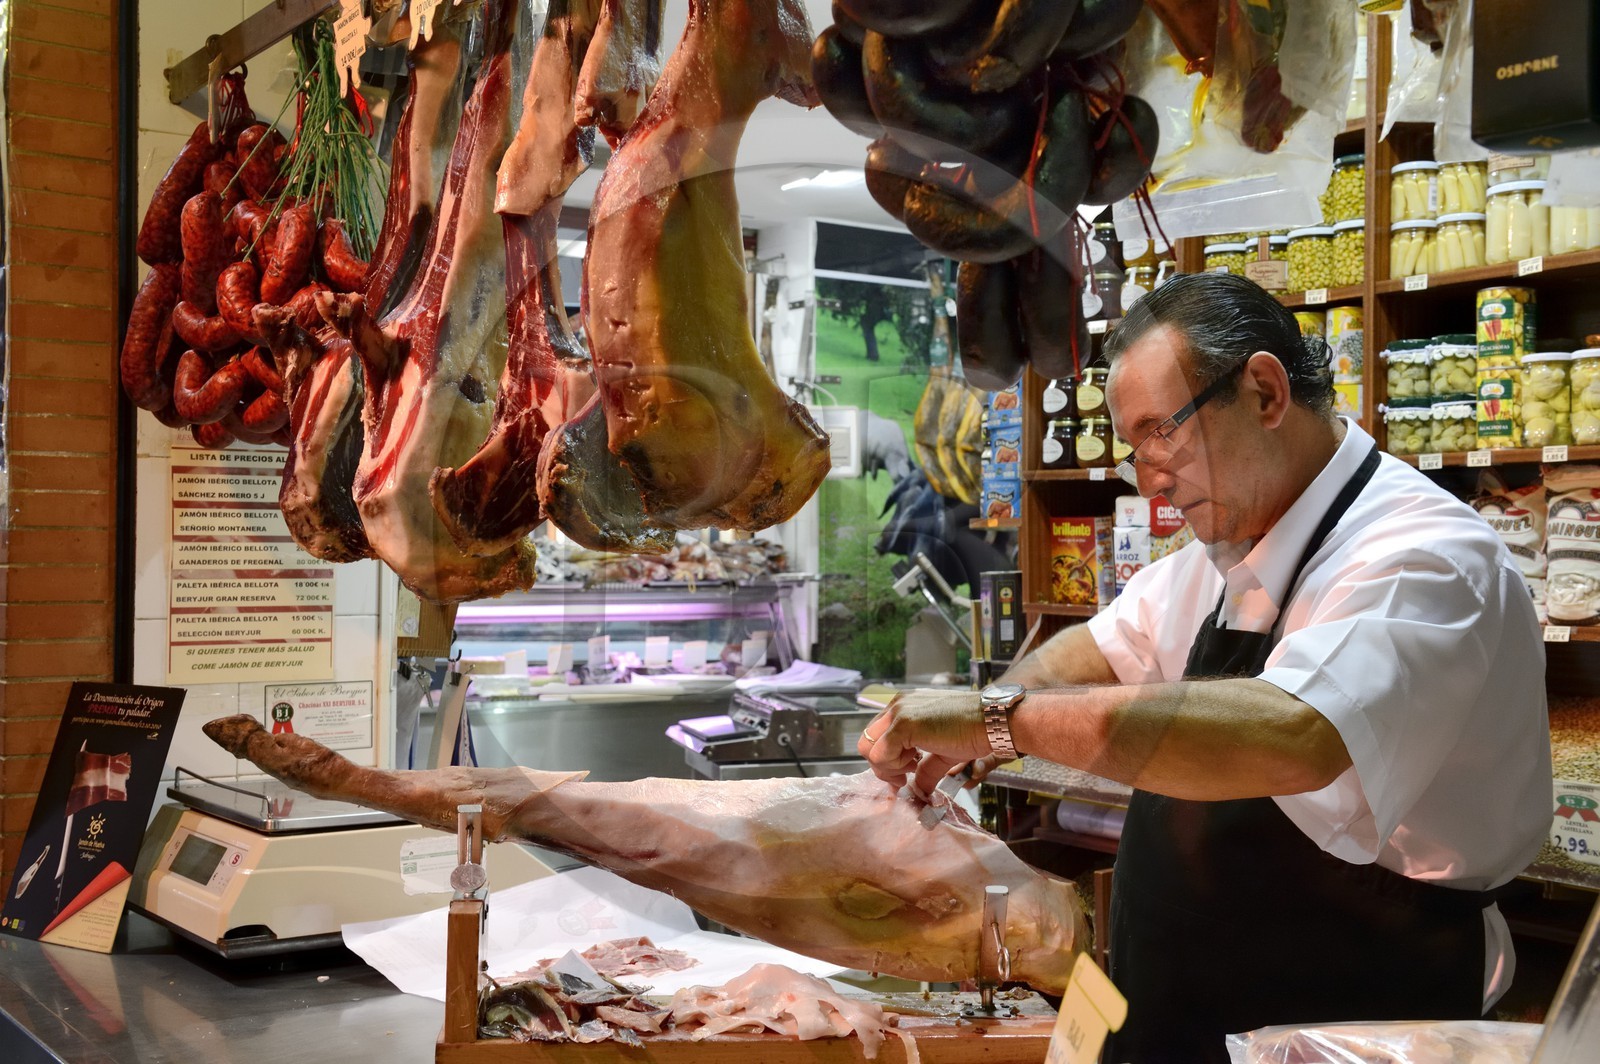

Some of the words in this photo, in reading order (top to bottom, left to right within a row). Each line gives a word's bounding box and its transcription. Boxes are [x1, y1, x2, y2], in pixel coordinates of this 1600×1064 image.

[1496, 55, 1559, 80] OSBORNE
[190, 453, 217, 461] LISTA
[219, 454, 232, 462] DE
[234, 455, 274, 463] PRECIOS
[177, 476, 206, 484] JAMÓN
[207, 477, 241, 485] IBÉRICO
[242, 478, 277, 486] BELLOTA
[178, 490, 216, 498] SÁNCHEZ
[179, 510, 208, 518] JAMÓN
[209, 510, 242, 518] IBÉRICO
[1157, 506, 1185, 519] CIGA
[179, 524, 216, 532] SEÑORÍO
[1052, 522, 1091, 537] brillante
[178, 544, 208, 552] JAMÓN
[209, 544, 242, 552] IBÉRICO
[243, 558, 284, 566] FREGENAL
[209, 580, 243, 588] IBÉRICA
[243, 581, 280, 589] BELLOTA
[176, 595, 214, 603] BERYJUR
[208, 615, 242, 623] IBÉRICA
[243, 615, 279, 623] BELLOTA
[177, 629, 223, 637] SELECCIÓN
[317, 627, 326, 635] K.
[197, 647, 236, 656] QUIERES
[237, 647, 265, 655] TENER
[267, 645, 286, 653] MÁS
[287, 645, 315, 653] SALUD
[218, 661, 250, 669] JAMÓN
[264, 660, 303, 668] BERYJUR
[273, 687, 286, 699] El
[286, 687, 315, 697] Sabor
[316, 687, 327, 696] de
[330, 685, 368, 698] Beryjur
[83, 692, 92, 701] La
[92, 692, 135, 705] Denominación
[134, 694, 142, 704] de
[142, 696, 165, 710] Origen
[117, 707, 125, 715] tu
